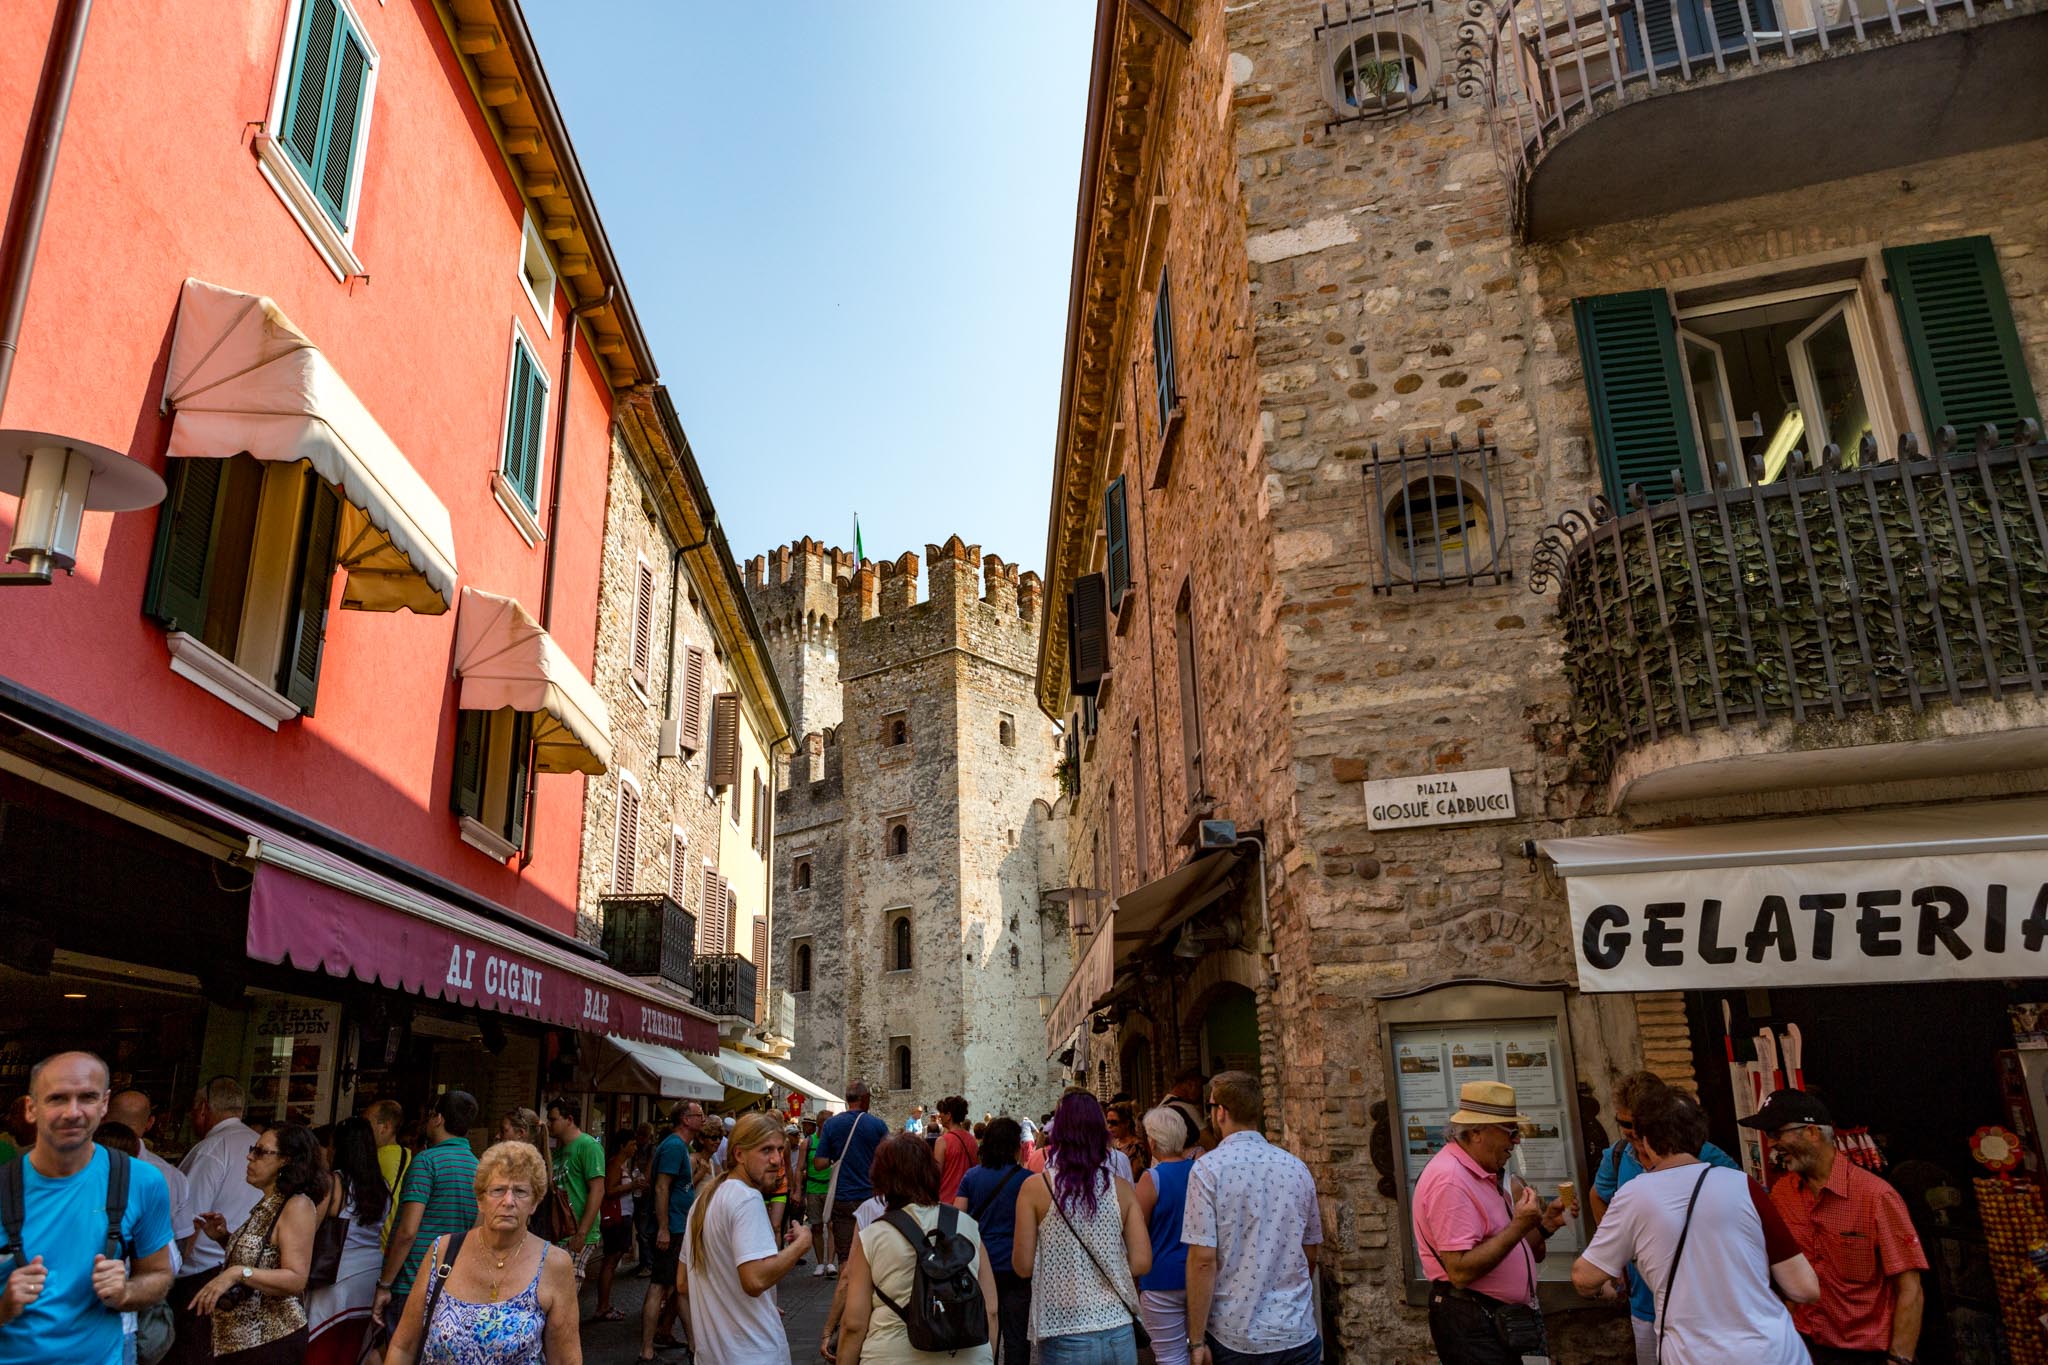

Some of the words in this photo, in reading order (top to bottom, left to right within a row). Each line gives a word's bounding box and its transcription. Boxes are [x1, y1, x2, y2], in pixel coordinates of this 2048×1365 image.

[1417, 781, 1458, 796] PIAZZA
[1436, 794, 1510, 816] CARDUCCI
[446, 944, 476, 989] AI
[484, 955, 543, 1006] CIGNI
[583, 988, 609, 1023] BAR
[641, 1007, 684, 1041] PIZZERIA
[267, 1007, 324, 1022] STEAK
[258, 1021, 329, 1035] GARDEN
